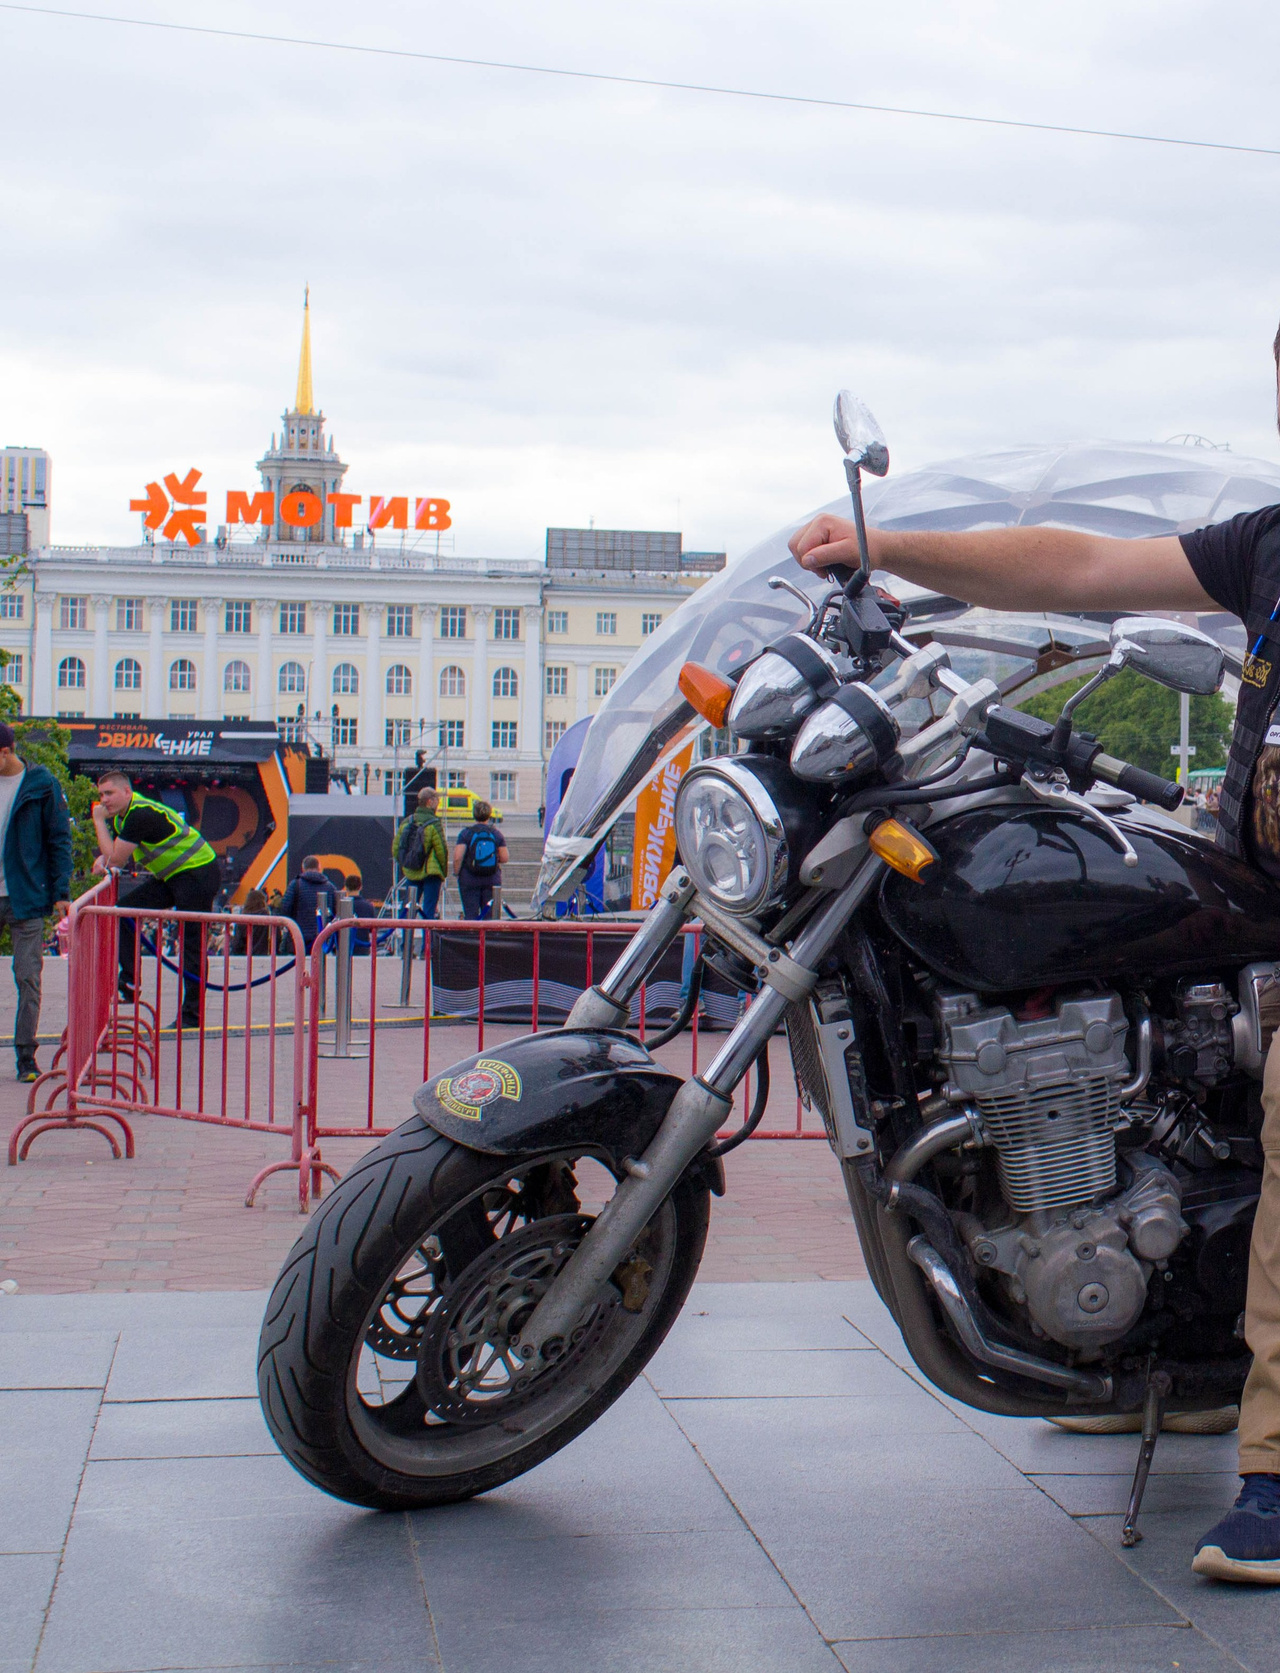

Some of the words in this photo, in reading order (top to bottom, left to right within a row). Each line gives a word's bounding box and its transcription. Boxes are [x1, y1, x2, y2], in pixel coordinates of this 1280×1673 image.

[225, 489, 452, 531] МОТИВ
[99, 723, 149, 732] ФЕСТИВАЛЬ
[187, 730, 215, 739] УРАЛ
[481, 1061, 517, 1095] ГРИФОНЫ
